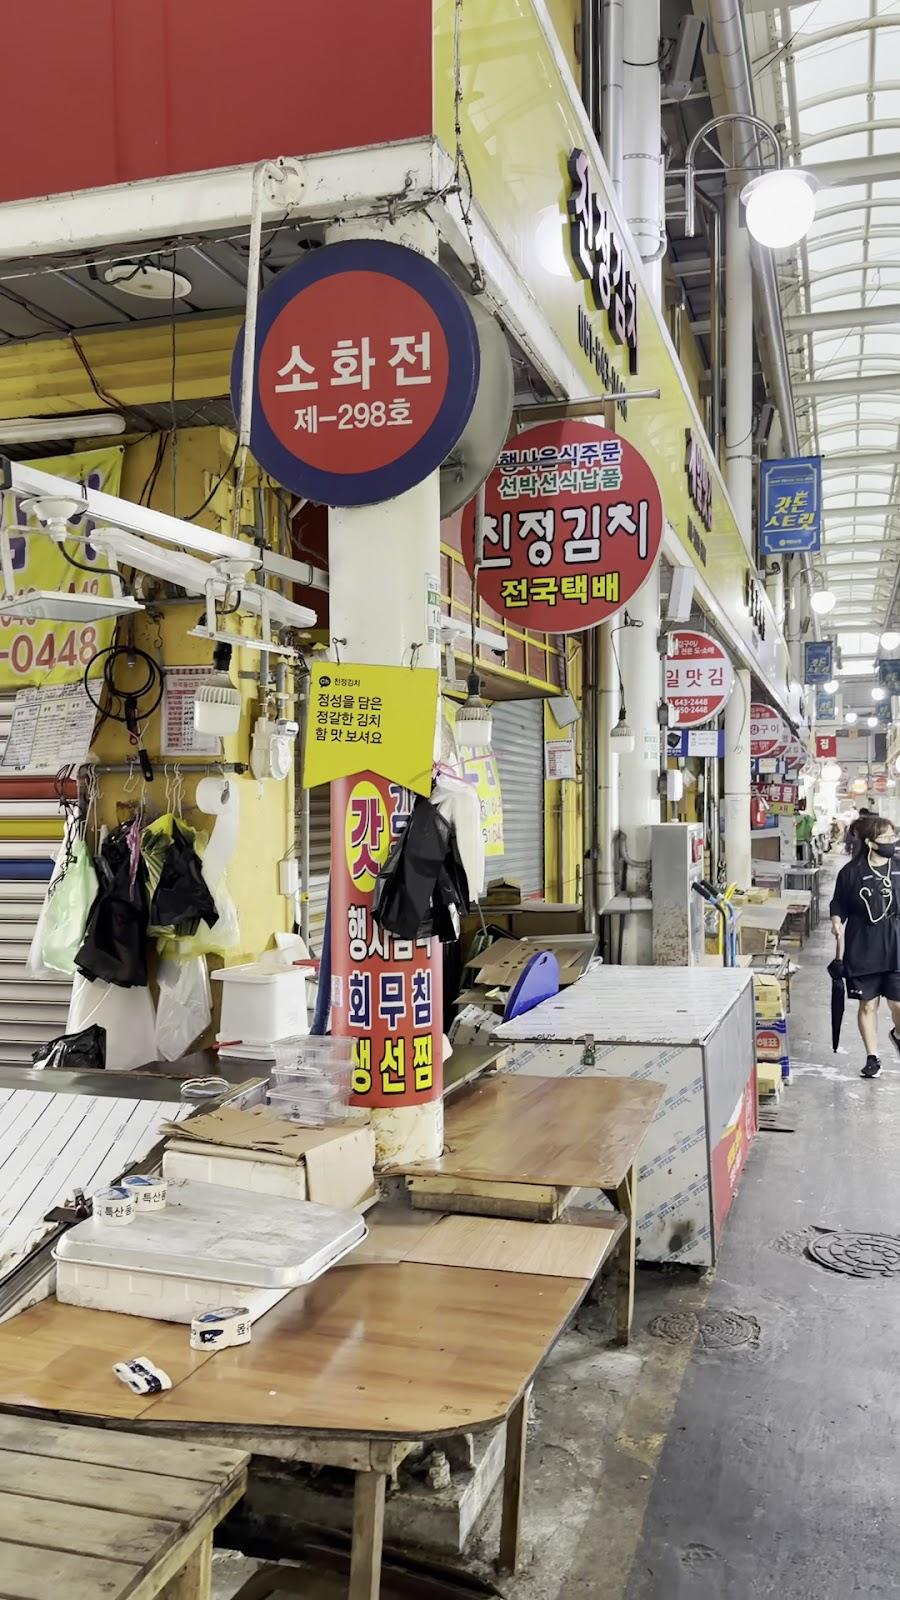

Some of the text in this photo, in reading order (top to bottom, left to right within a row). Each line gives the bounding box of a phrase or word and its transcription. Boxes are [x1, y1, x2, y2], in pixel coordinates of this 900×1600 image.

[274, 331, 432, 393] 소화전
[293, 398, 413, 434] 제-298호
[499, 467, 621, 500] 선박선식납품
[478, 499, 649, 571] 친정김치
[500, 571, 621, 609] 전국택배
[334, 678, 361, 687] 친정김치
[316, 710, 381, 728] 정갈한 김치
[318, 693, 382, 711] 정성을 담은
[315, 727, 382, 744] 함 맛 보셔요
[351, 797, 384, 879] 갓
[347, 904, 432, 961] 행사
[348, 970, 432, 1031] 회무침
[351, 1033, 433, 1095] 생선찜
